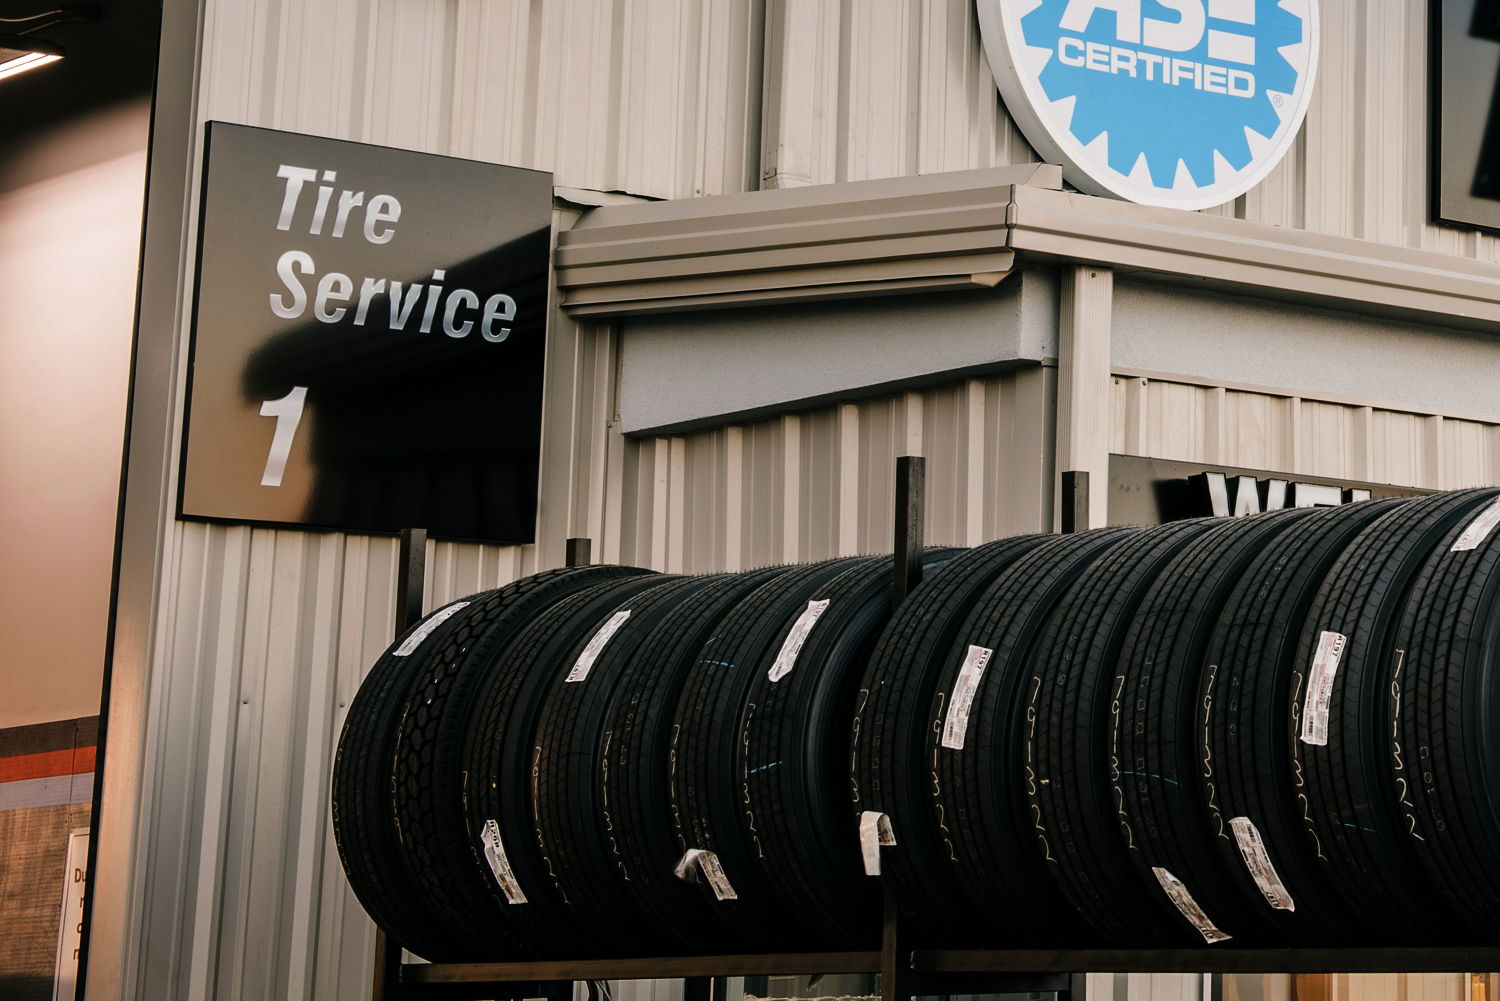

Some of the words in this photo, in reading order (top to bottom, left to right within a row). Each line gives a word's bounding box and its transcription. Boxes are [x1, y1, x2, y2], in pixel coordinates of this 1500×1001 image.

[1058, 36, 1256, 99] CERTIFIED
[275, 165, 402, 245] Tire
[269, 250, 517, 343] Service
[258, 386, 309, 487] 1
